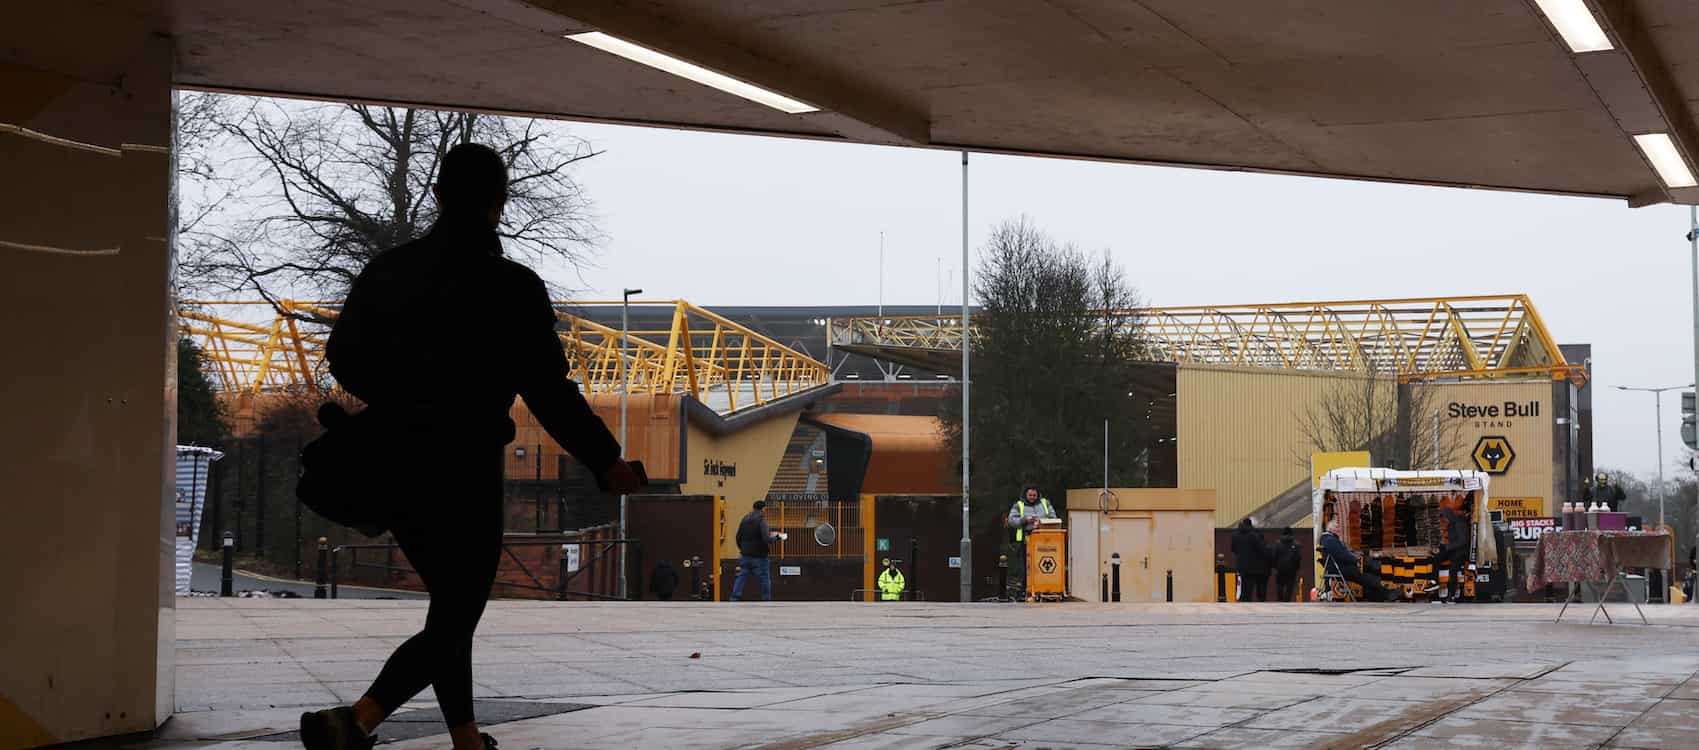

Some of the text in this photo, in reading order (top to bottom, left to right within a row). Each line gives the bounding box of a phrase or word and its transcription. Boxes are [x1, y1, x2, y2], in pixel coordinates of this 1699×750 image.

[1448, 401, 1540, 418] Steve Bull
[1475, 421, 1512, 429] STAND
[1497, 499, 1524, 507] HOME
[1526, 519, 1555, 527] STACKS
